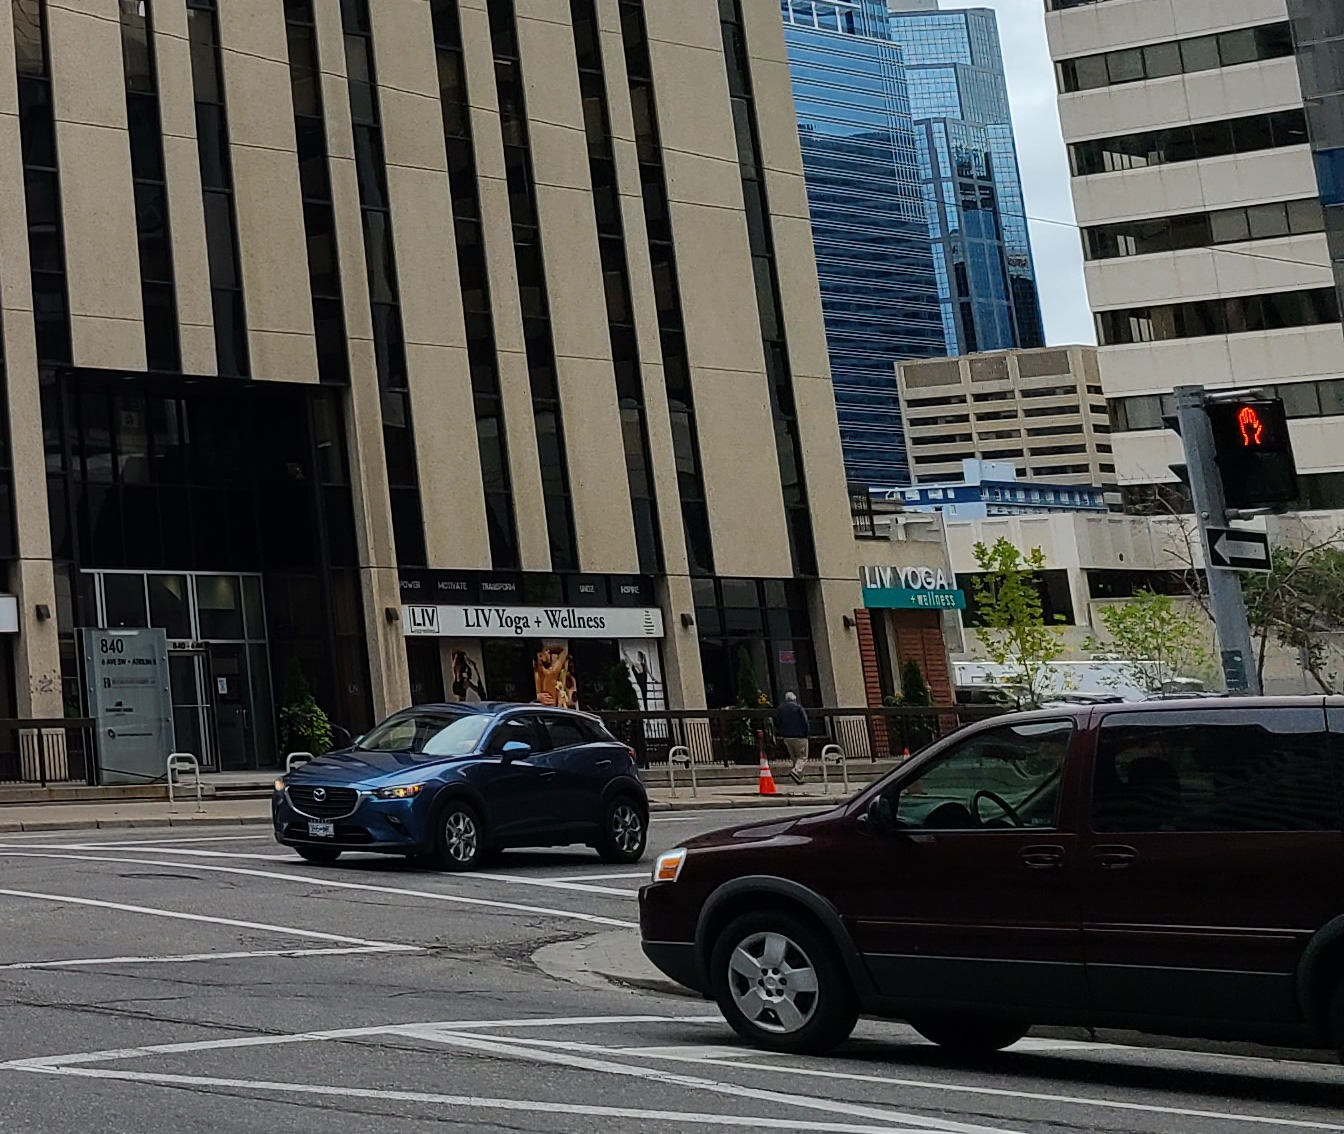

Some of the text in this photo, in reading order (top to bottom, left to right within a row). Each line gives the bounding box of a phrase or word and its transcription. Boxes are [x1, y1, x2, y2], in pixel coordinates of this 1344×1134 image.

[865, 566, 949, 590] LIV YOGA
[412, 608, 435, 626] LIV
[463, 609, 492, 627] LIV
[494, 609, 530, 634] Yoga
[543, 609, 605, 629] Wellness
[100, 639, 124, 654] 840
